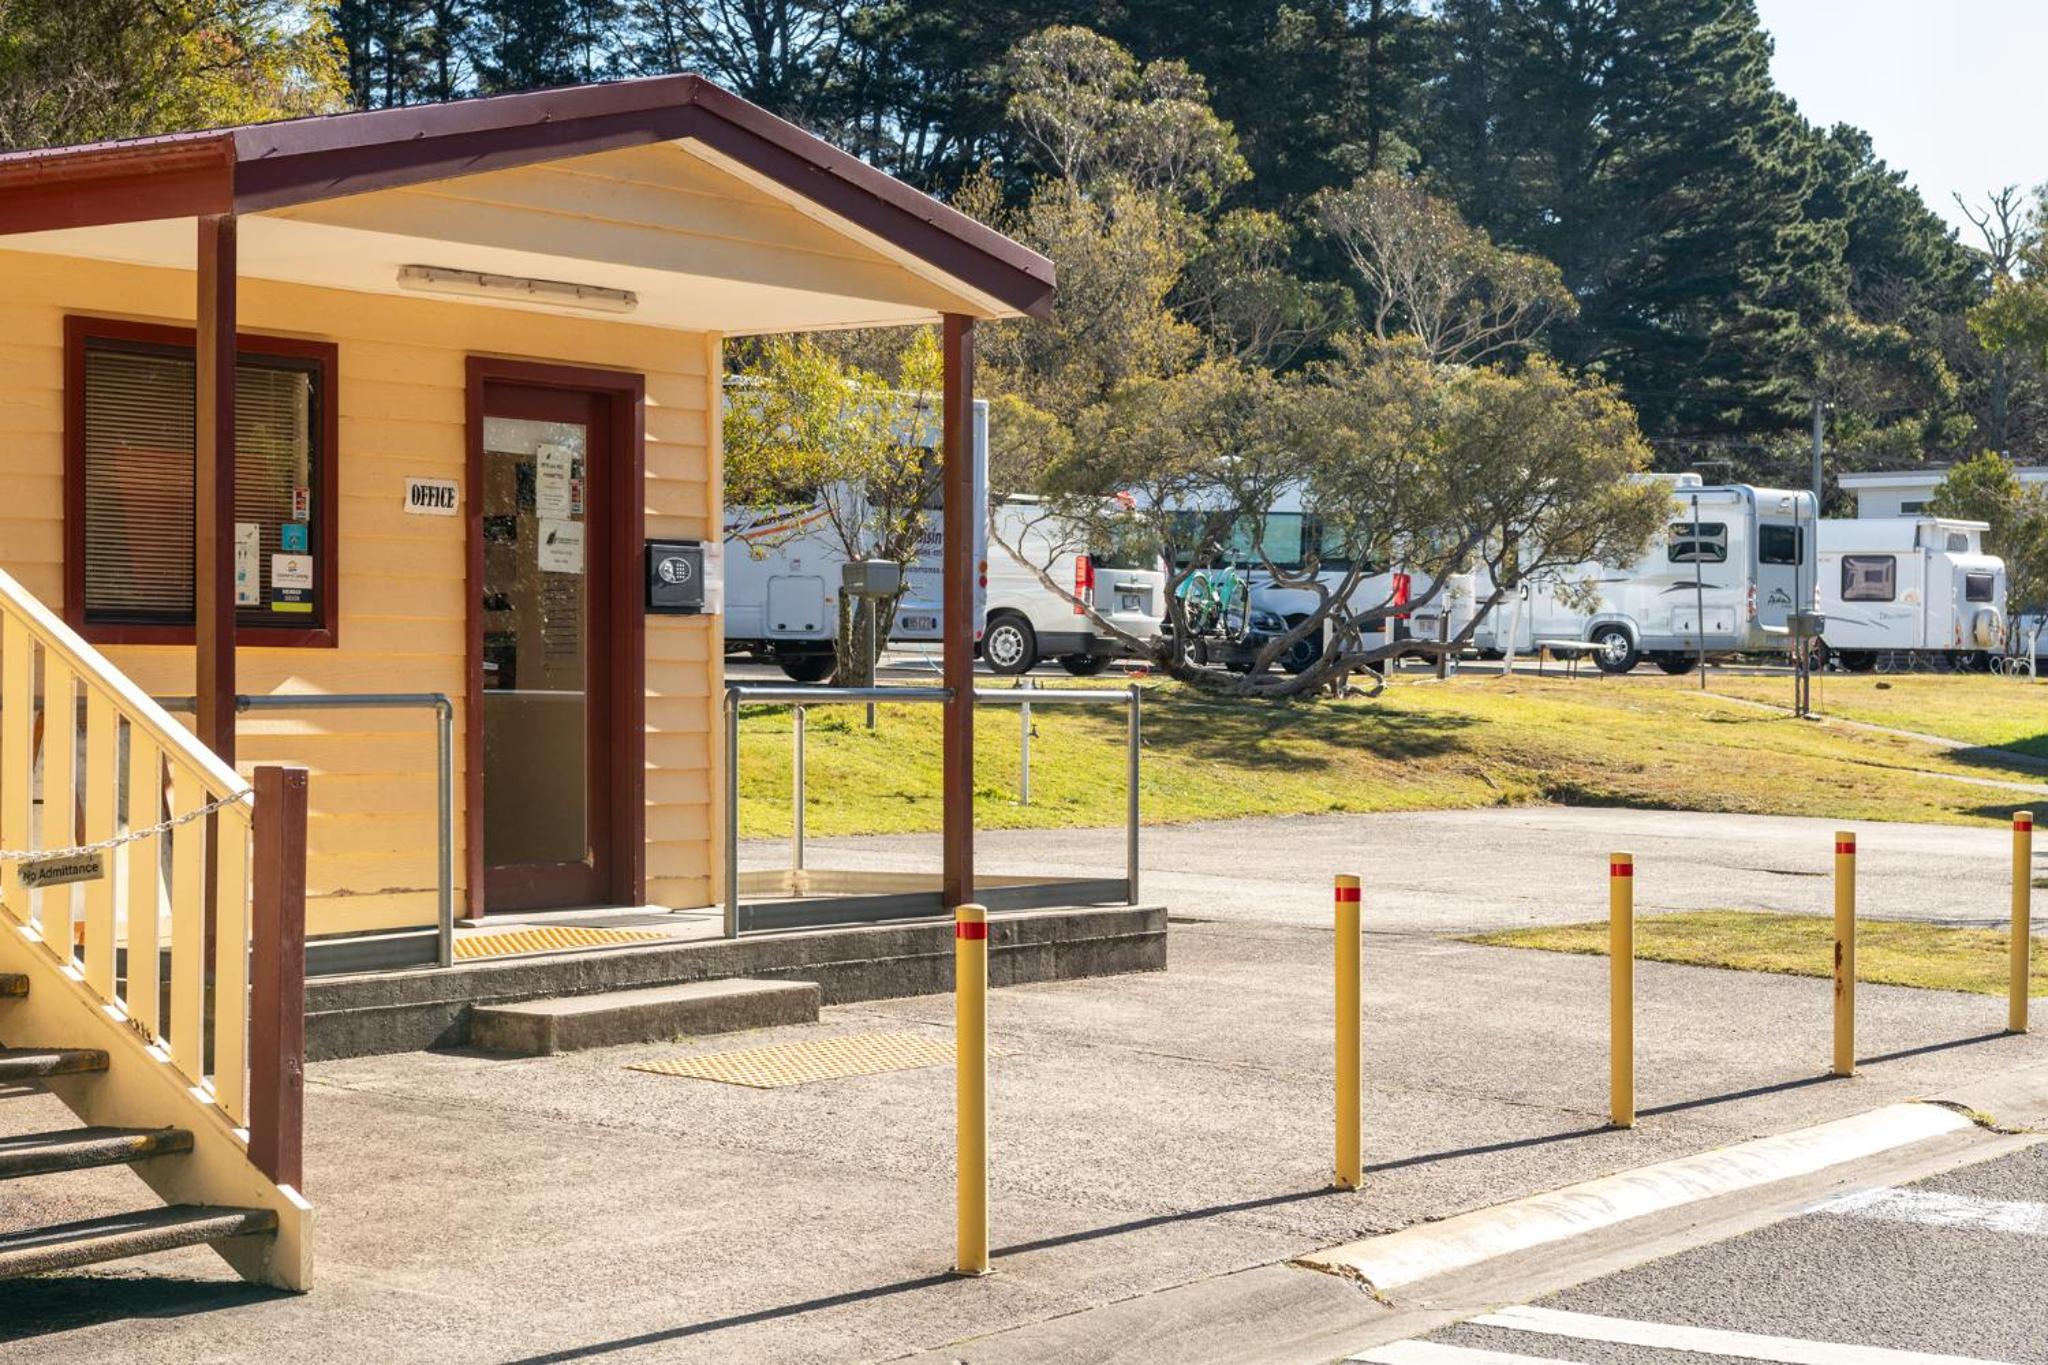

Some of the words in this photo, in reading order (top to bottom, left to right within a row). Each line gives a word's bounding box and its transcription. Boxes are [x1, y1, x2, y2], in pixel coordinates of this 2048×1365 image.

[411, 484, 455, 508] OFFICE
[22, 871, 36, 882] No
[39, 863, 98, 879] Admittance
